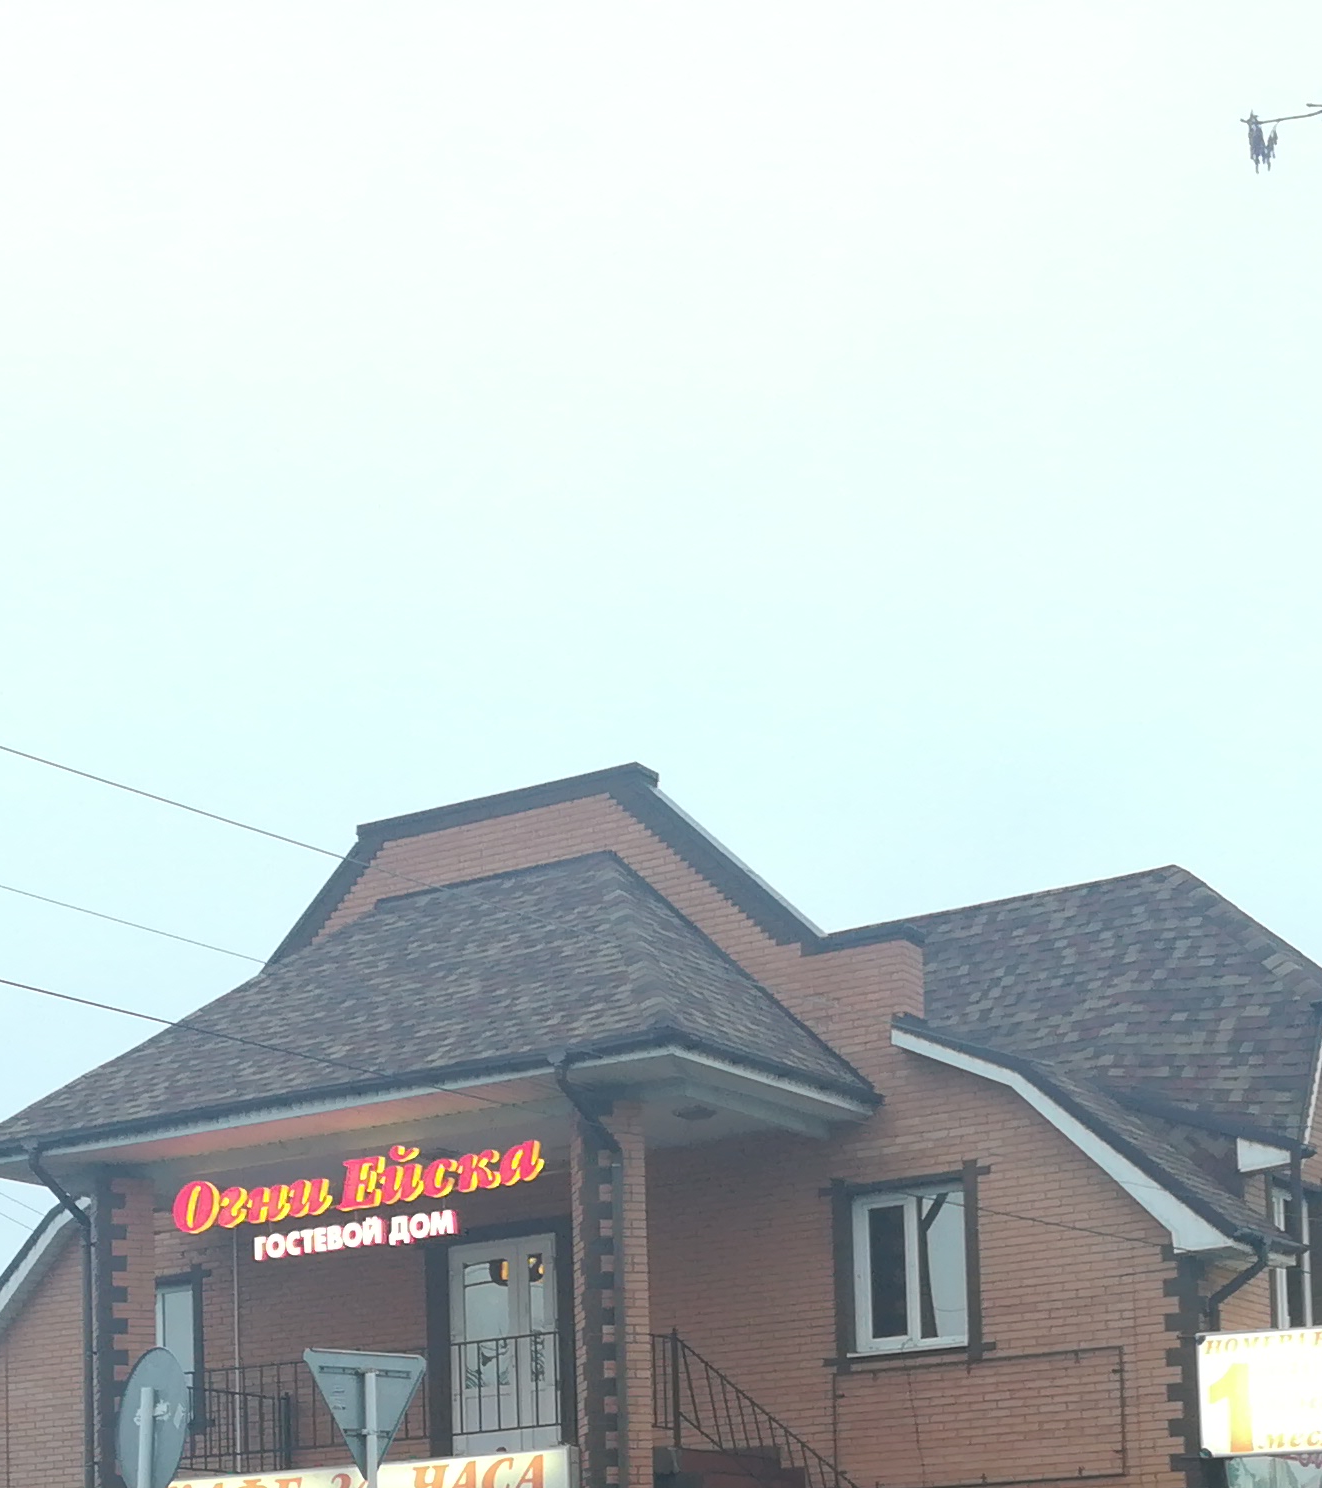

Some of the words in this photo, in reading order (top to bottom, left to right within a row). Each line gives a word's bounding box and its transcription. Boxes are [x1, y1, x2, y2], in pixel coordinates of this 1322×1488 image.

[172, 1175, 333, 1234] Огни
[336, 1139, 545, 1212] Ейска
[254, 1216, 386, 1261] ГОСТЕВОЙ
[388, 1210, 460, 1245] ДОМ
[1208, 1363, 1254, 1452] 1
